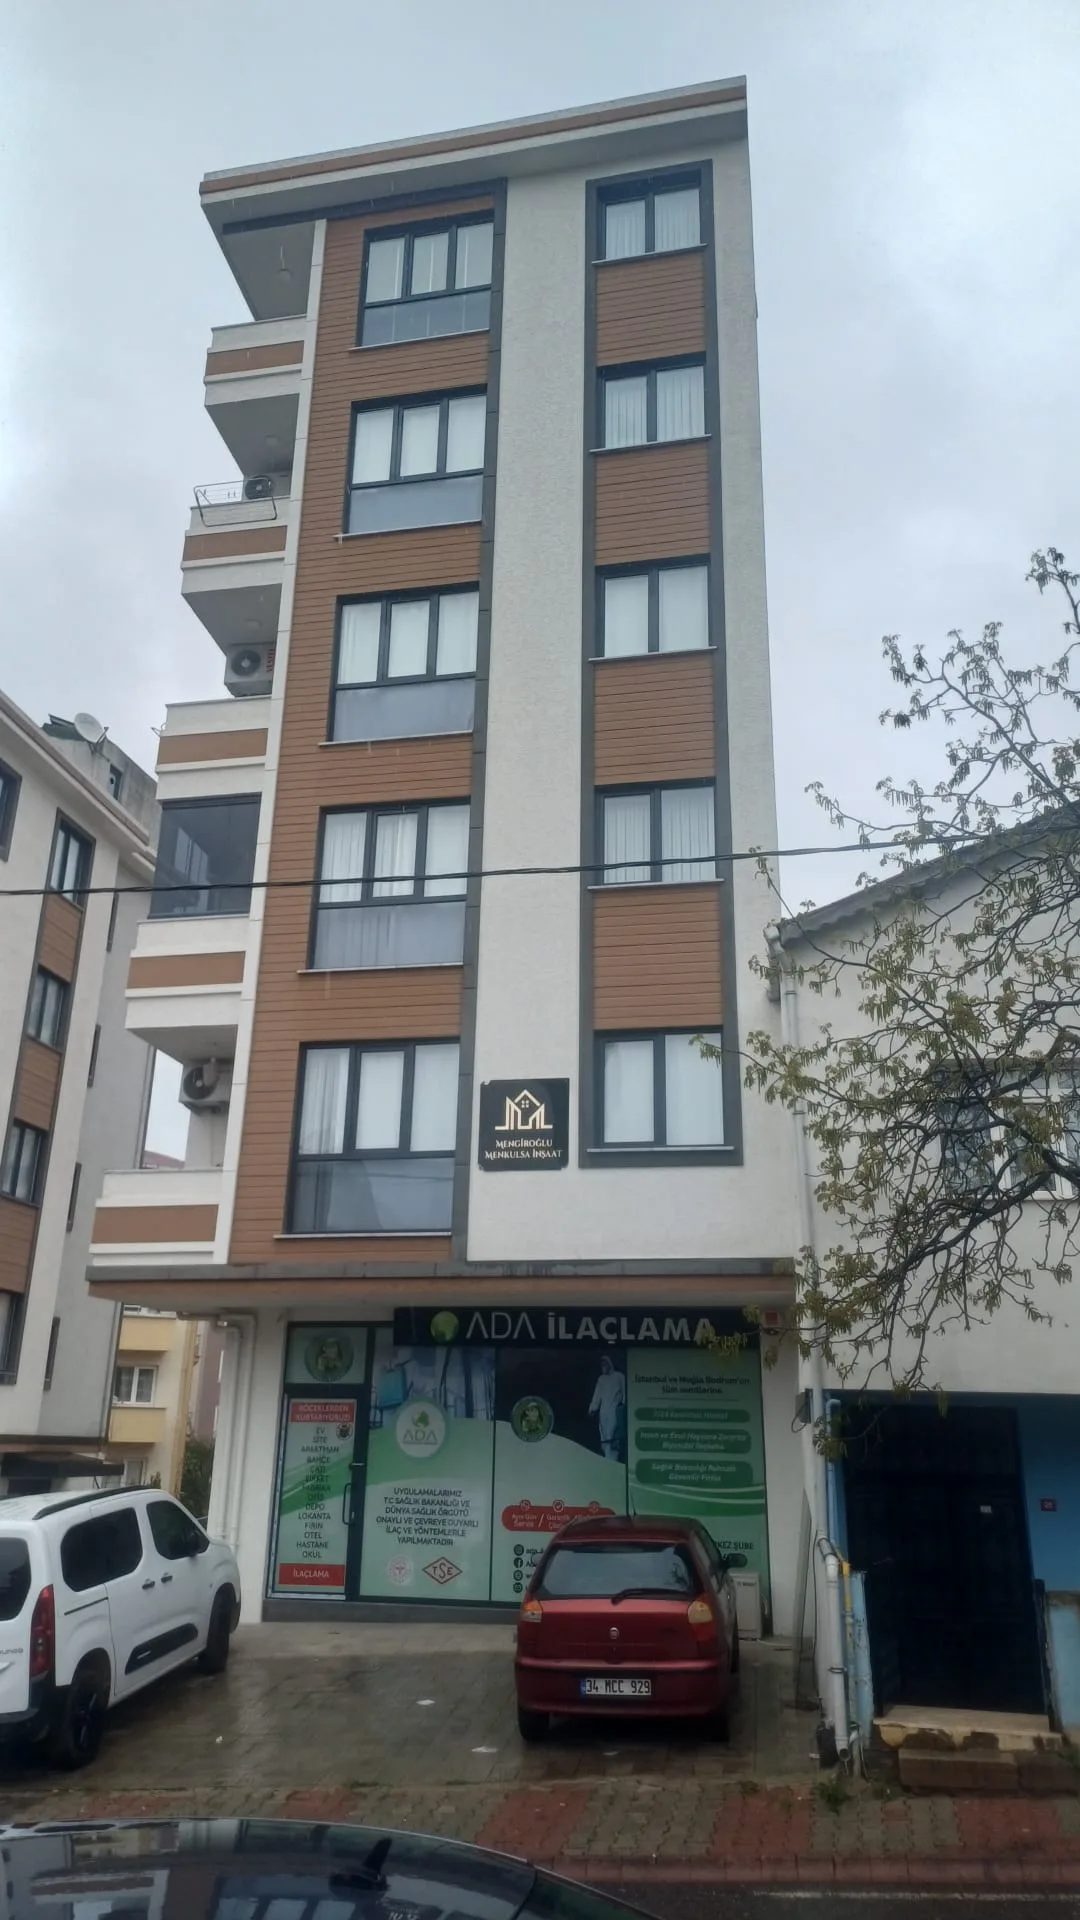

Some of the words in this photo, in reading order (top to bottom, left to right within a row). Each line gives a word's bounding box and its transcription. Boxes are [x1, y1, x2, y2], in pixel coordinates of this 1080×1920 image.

[495, 1138, 553, 1149] MENGİROĞLU
[533, 1148, 563, 1159] İNŞAAT
[466, 1311, 536, 1340] ADA
[547, 1312, 715, 1344] İLAÇLAMA
[316, 1426, 325, 1434] EV
[403, 1430, 437, 1441] ADA
[301, 1445, 339, 1453] APARTMAN
[394, 1487, 463, 1497] UYGULAMALARIMIZ
[421, 1497, 459, 1507] BAKANLIĞI
[460, 1500, 471, 1508] VE
[298, 1512, 331, 1520] LOKANTA
[385, 1506, 410, 1514] DÜNYA
[411, 1507, 436, 1516] SAĞLIK
[437, 1507, 469, 1517] ÖRGÜTÜ
[376, 1516, 401, 1524] ONAYLI
[414, 1517, 446, 1527] ÇEVREYE
[447, 1519, 479, 1528] DUYARLI
[304, 1531, 322, 1539] OTEL
[386, 1525, 401, 1535] İLAÇ
[414, 1526, 466, 1537] YÖNTEMLERLE
[296, 1541, 329, 1549] HASTANE
[734, 1541, 755, 1551] ŞUBE
[302, 1550, 322, 1559] OKUL
[293, 1567, 330, 1579] İLAÇLAMA
[432, 1562, 454, 1578] TSE
[586, 1680, 599, 1693] 34
[605, 1680, 625, 1693] MCC
[631, 1681, 650, 1694] 929
